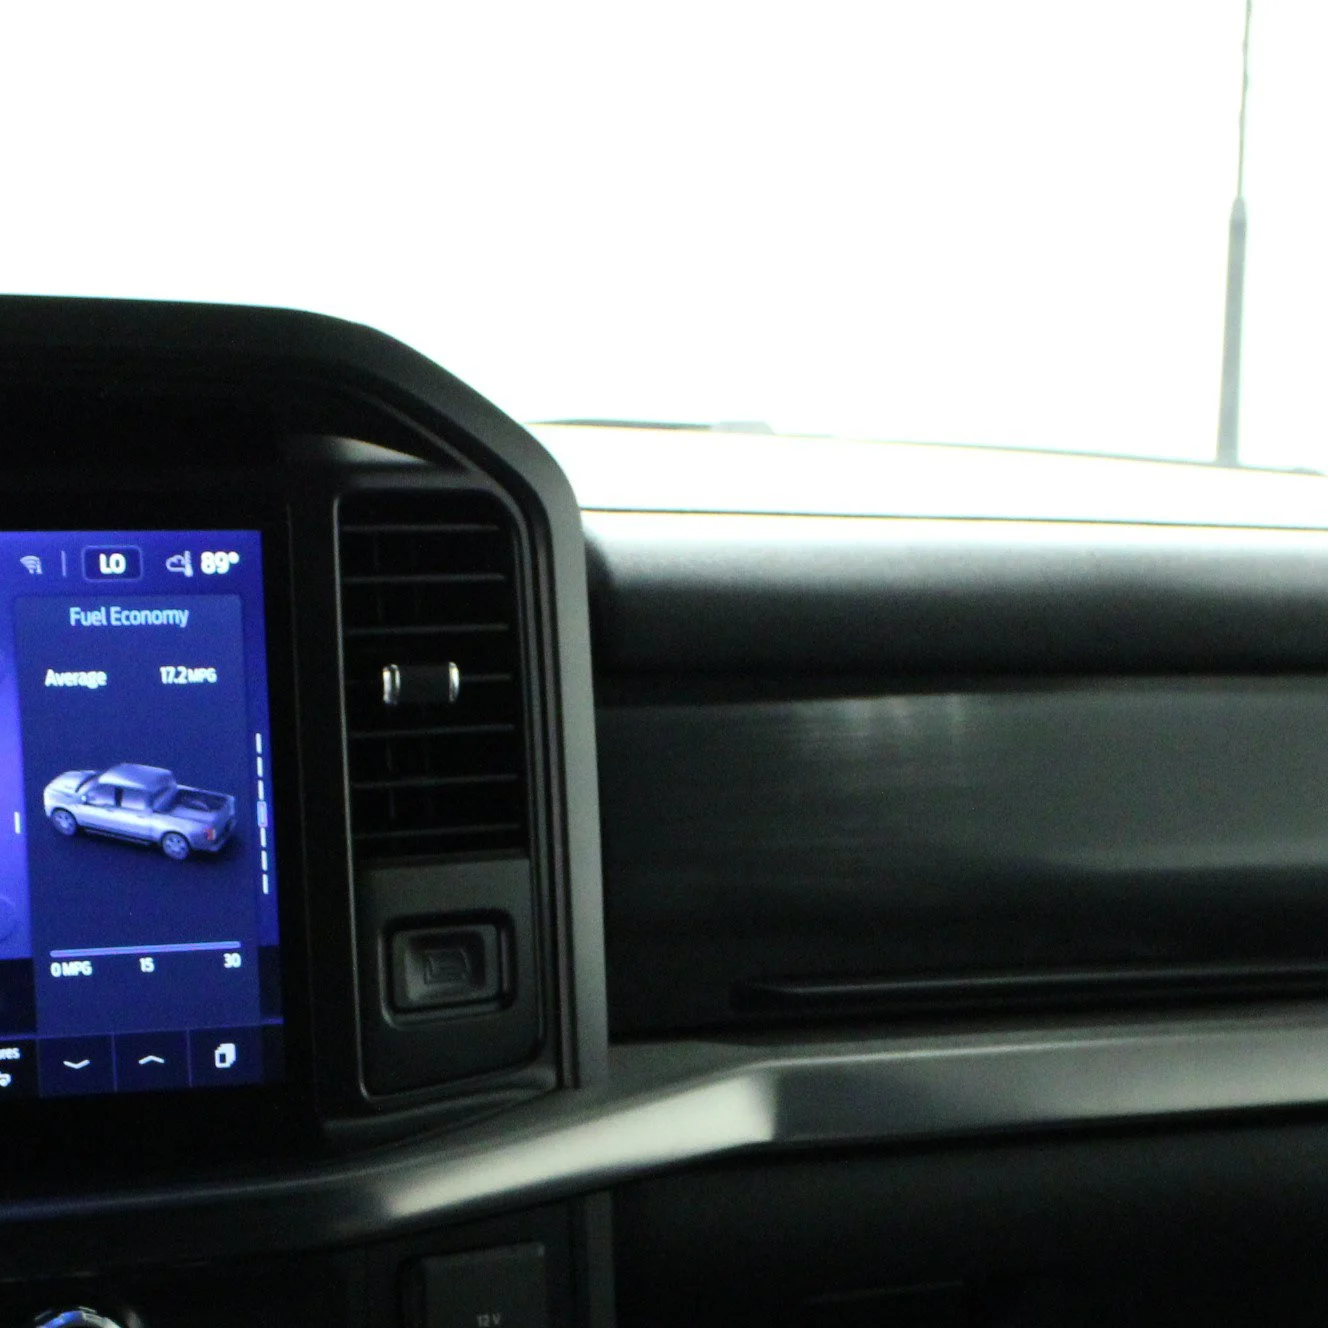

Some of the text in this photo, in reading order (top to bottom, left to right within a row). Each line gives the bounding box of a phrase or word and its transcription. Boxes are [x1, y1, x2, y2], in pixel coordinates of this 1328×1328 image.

[99, 552, 127, 575] LO
[69, 605, 189, 629] Fuel Economy
[44, 667, 108, 690] Average
[139, 957, 154, 973] 15
[224, 953, 241, 968] 30
